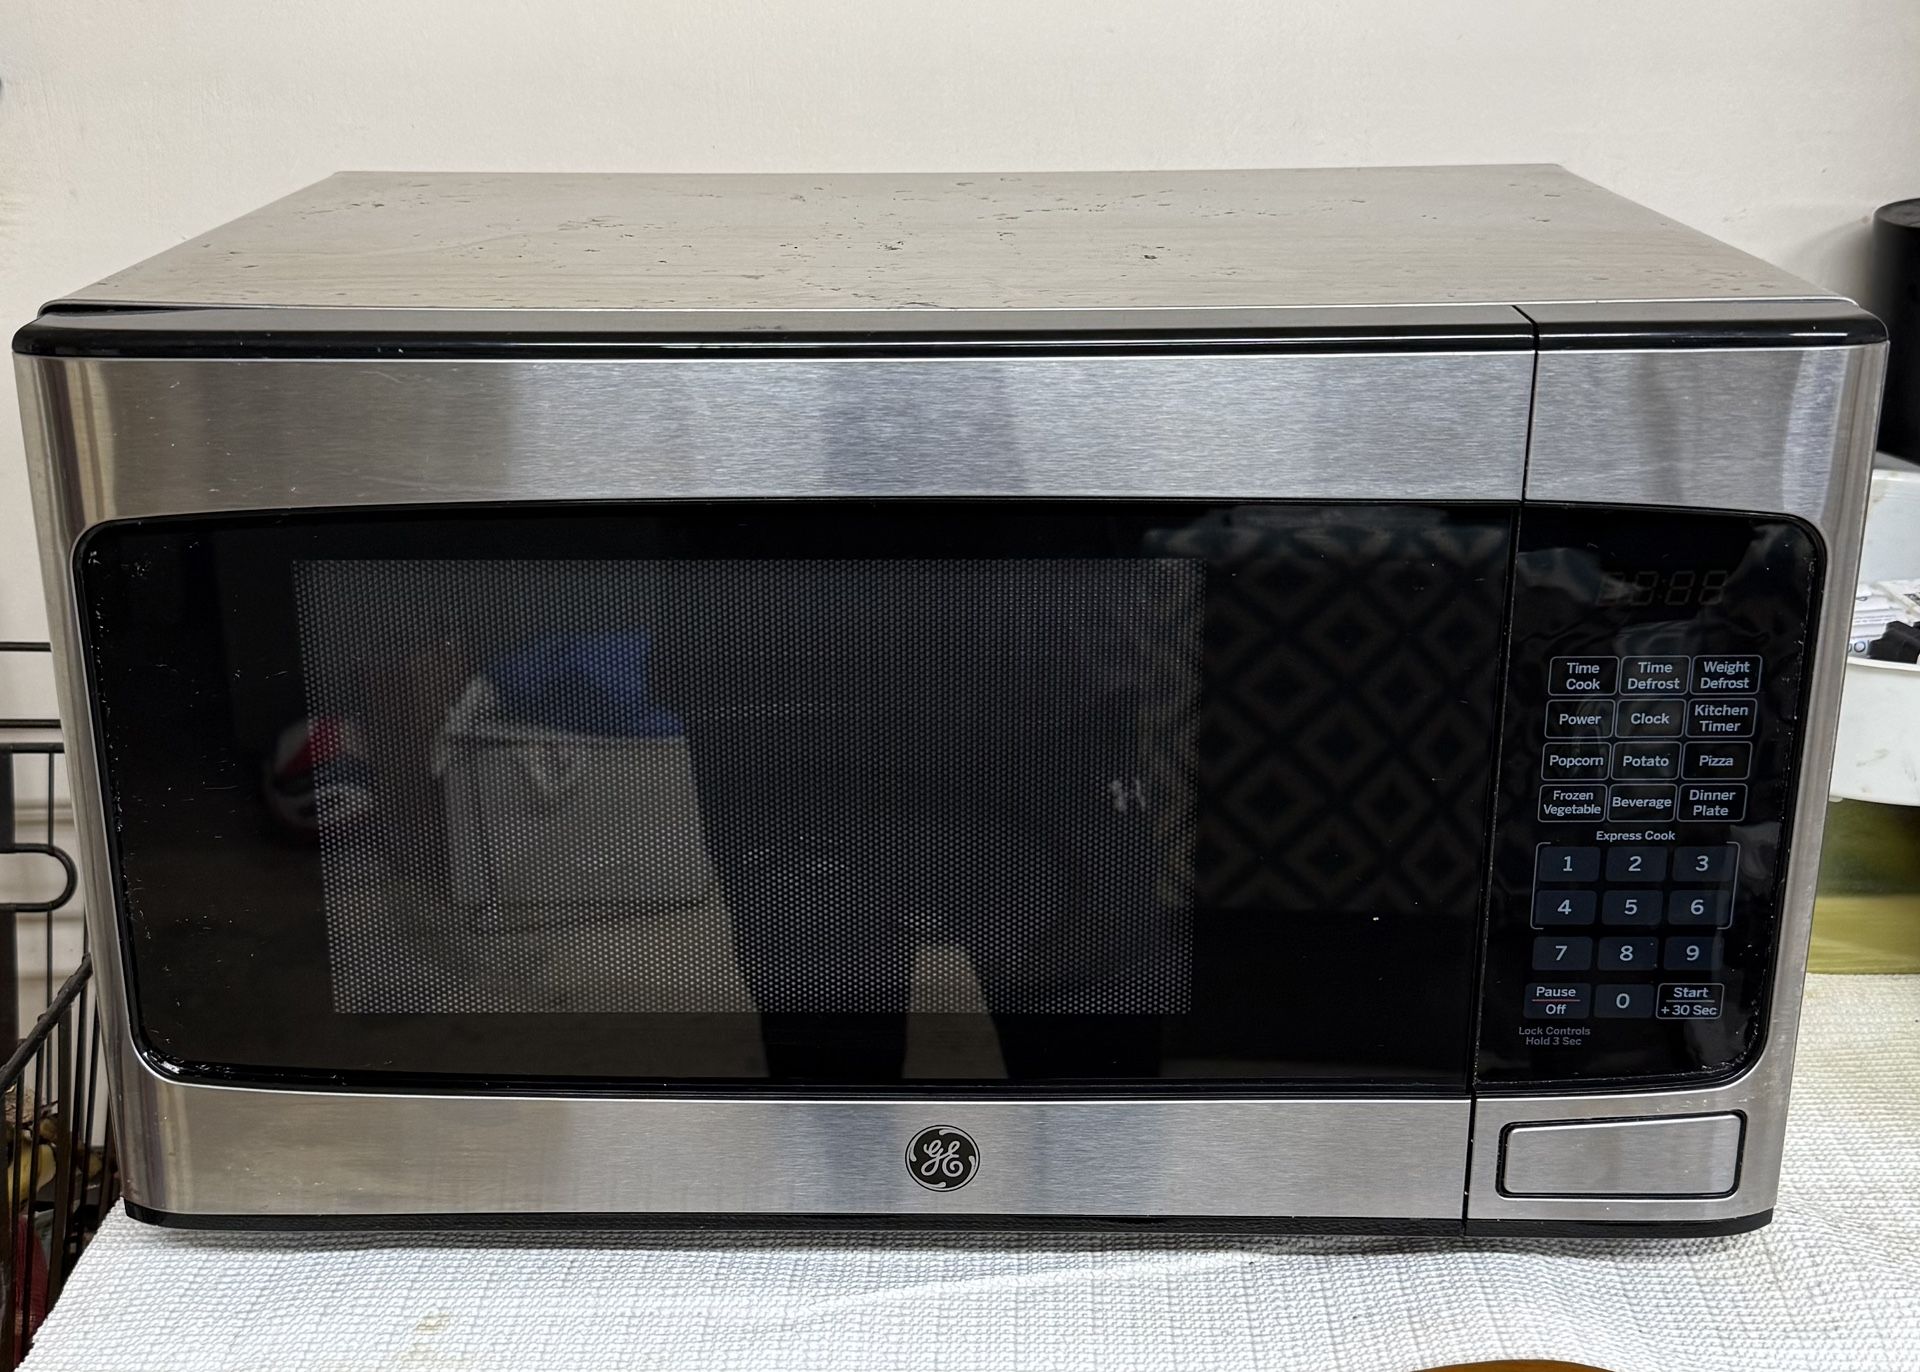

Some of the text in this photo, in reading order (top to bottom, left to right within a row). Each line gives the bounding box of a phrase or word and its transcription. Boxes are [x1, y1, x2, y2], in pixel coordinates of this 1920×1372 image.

[1567, 663, 1600, 674] Time
[1638, 662, 1672, 673] Time
[1704, 661, 1749, 675] Weight
[1566, 679, 1600, 690] Cook
[1627, 678, 1680, 689] Defrost
[1701, 678, 1749, 689] Defrost
[1695, 705, 1748, 716] Kitchen
[1559, 714, 1601, 725] Power
[1631, 713, 1669, 724] Clock
[1700, 720, 1741, 732] Timer
[1550, 755, 1603, 769] Popcorn
[1623, 756, 1669, 767] Potato
[1699, 755, 1733, 766] Pizza
[1553, 791, 1594, 800] Frozen
[1689, 790, 1735, 801] Dinner
[1612, 797, 1672, 810] Beverage
[1544, 805, 1601, 817] Vegetable
[1693, 805, 1728, 816] Plate
[1596, 831, 1675, 843] Express Cook
[1563, 856, 1572, 872] 1
[1628, 856, 1641, 872] 2
[1696, 856, 1708, 872] 3
[1558, 900, 1571, 915] 4
[1624, 900, 1637, 915] 5
[1691, 900, 1704, 915] 6
[1556, 946, 1567, 960] 7
[1620, 946, 1634, 961] 8
[1686, 946, 1699, 961] 9
[1536, 987, 1576, 997] Pause
[1673, 987, 1708, 998] Start
[1616, 994, 1630, 1009] 0
[1546, 1005, 1566, 1015] Off
[1693, 1005, 1717, 1016] Sec
[1519, 1027, 1590, 1036] Lock Controls
[1526, 1037, 1581, 1045] Hold 3 Sec
